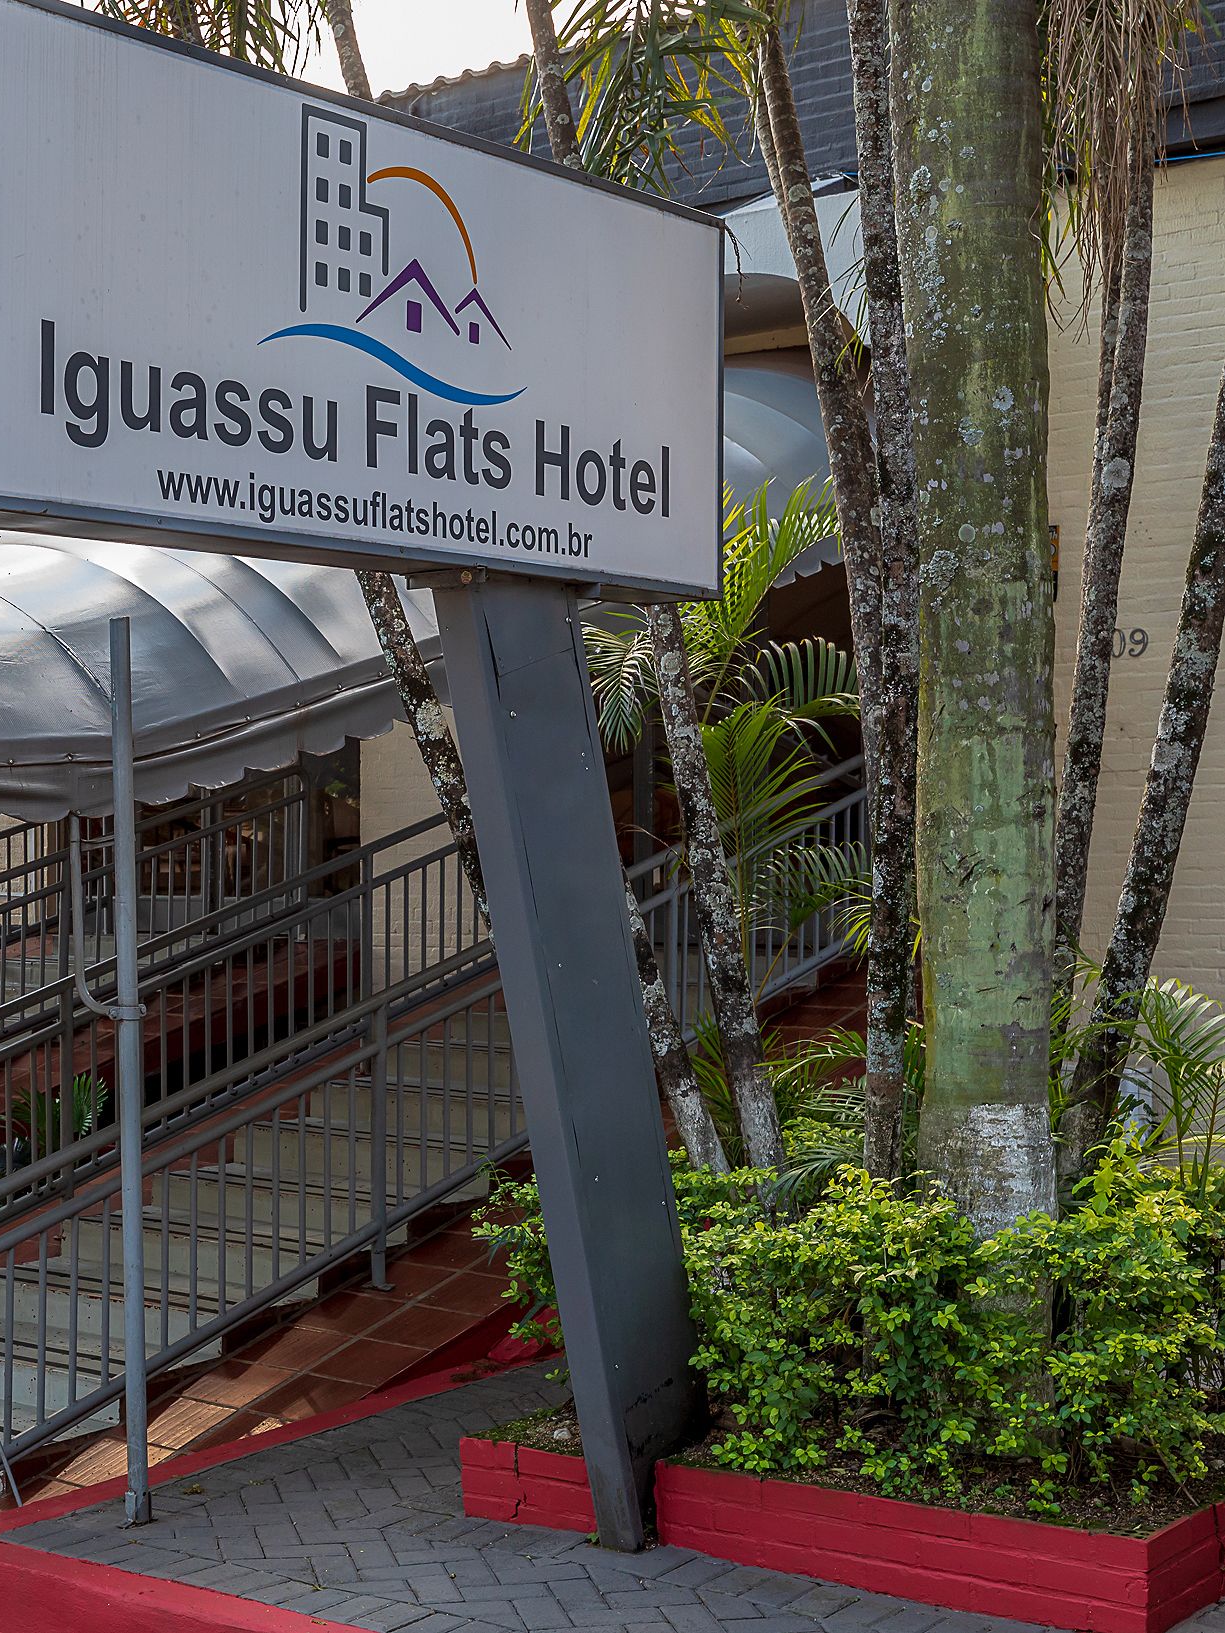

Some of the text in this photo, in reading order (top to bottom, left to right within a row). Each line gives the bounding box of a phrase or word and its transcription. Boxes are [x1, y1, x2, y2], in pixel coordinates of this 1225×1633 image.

[39, 319, 670, 518] Iguassu Flats Hotel
[156, 468, 593, 559] www.iguassuflatshotel.com.br
